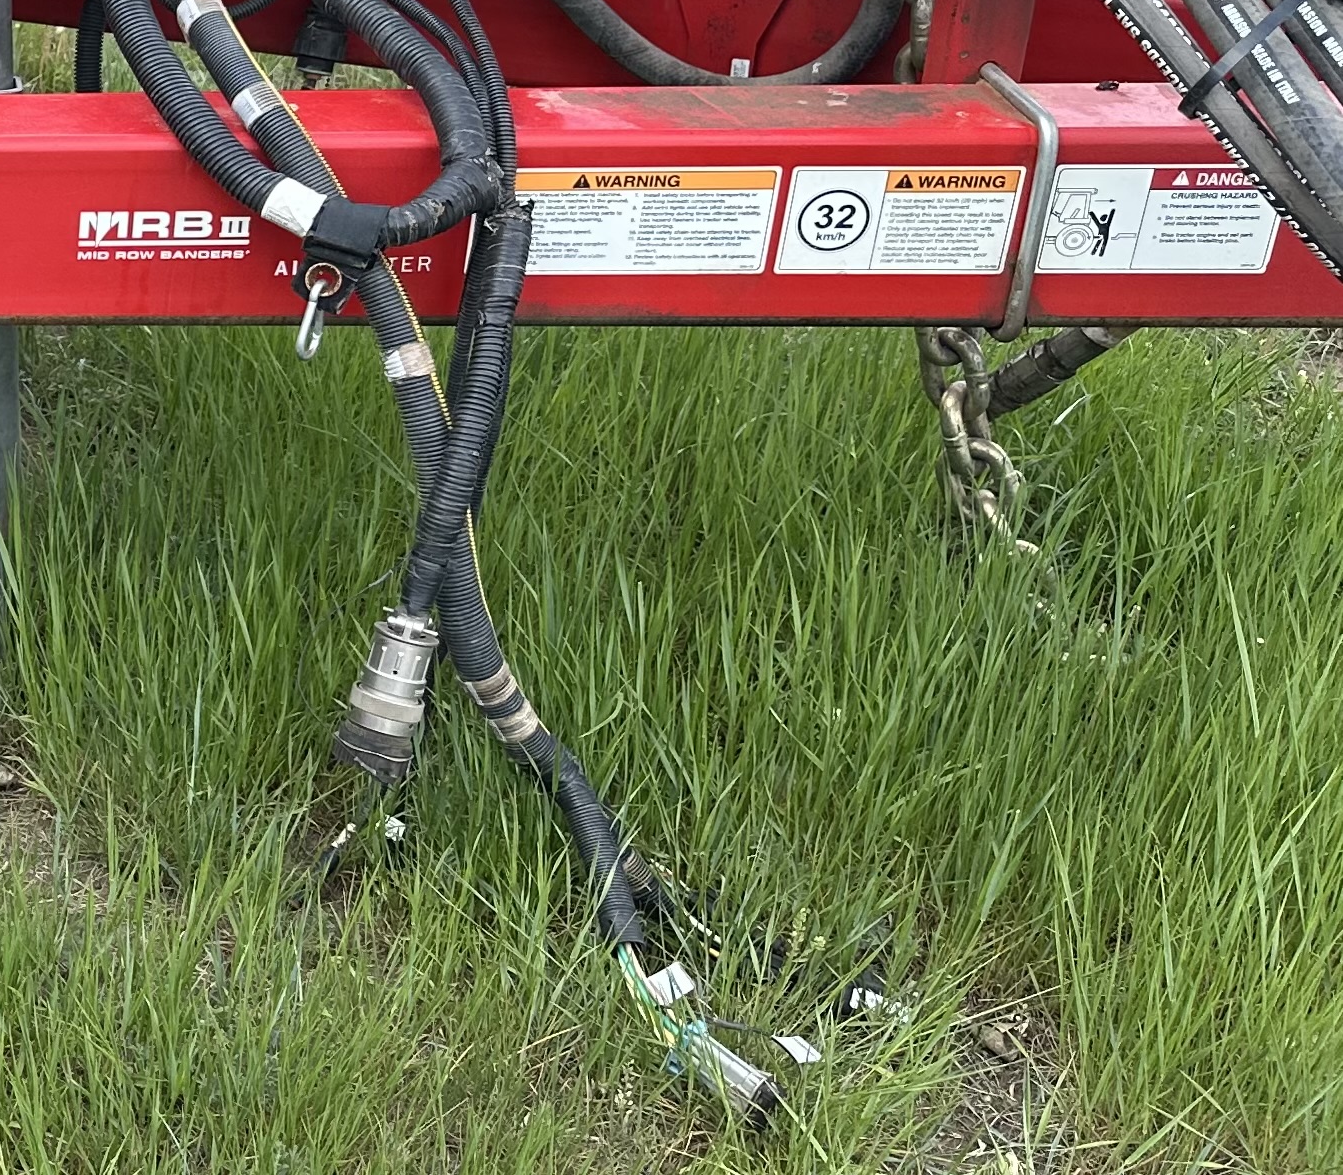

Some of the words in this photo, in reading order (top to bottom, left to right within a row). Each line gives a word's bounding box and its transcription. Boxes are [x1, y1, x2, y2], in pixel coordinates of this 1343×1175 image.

[595, 175, 681, 188] WARNING
[918, 175, 1006, 188] WARNING
[1195, 172, 1253, 186] DANGE
[814, 204, 857, 229] 32
[79, 210, 213, 242] MRB
[815, 232, 845, 241] km/h
[77, 250, 109, 260] MID
[115, 250, 155, 260] ROW
